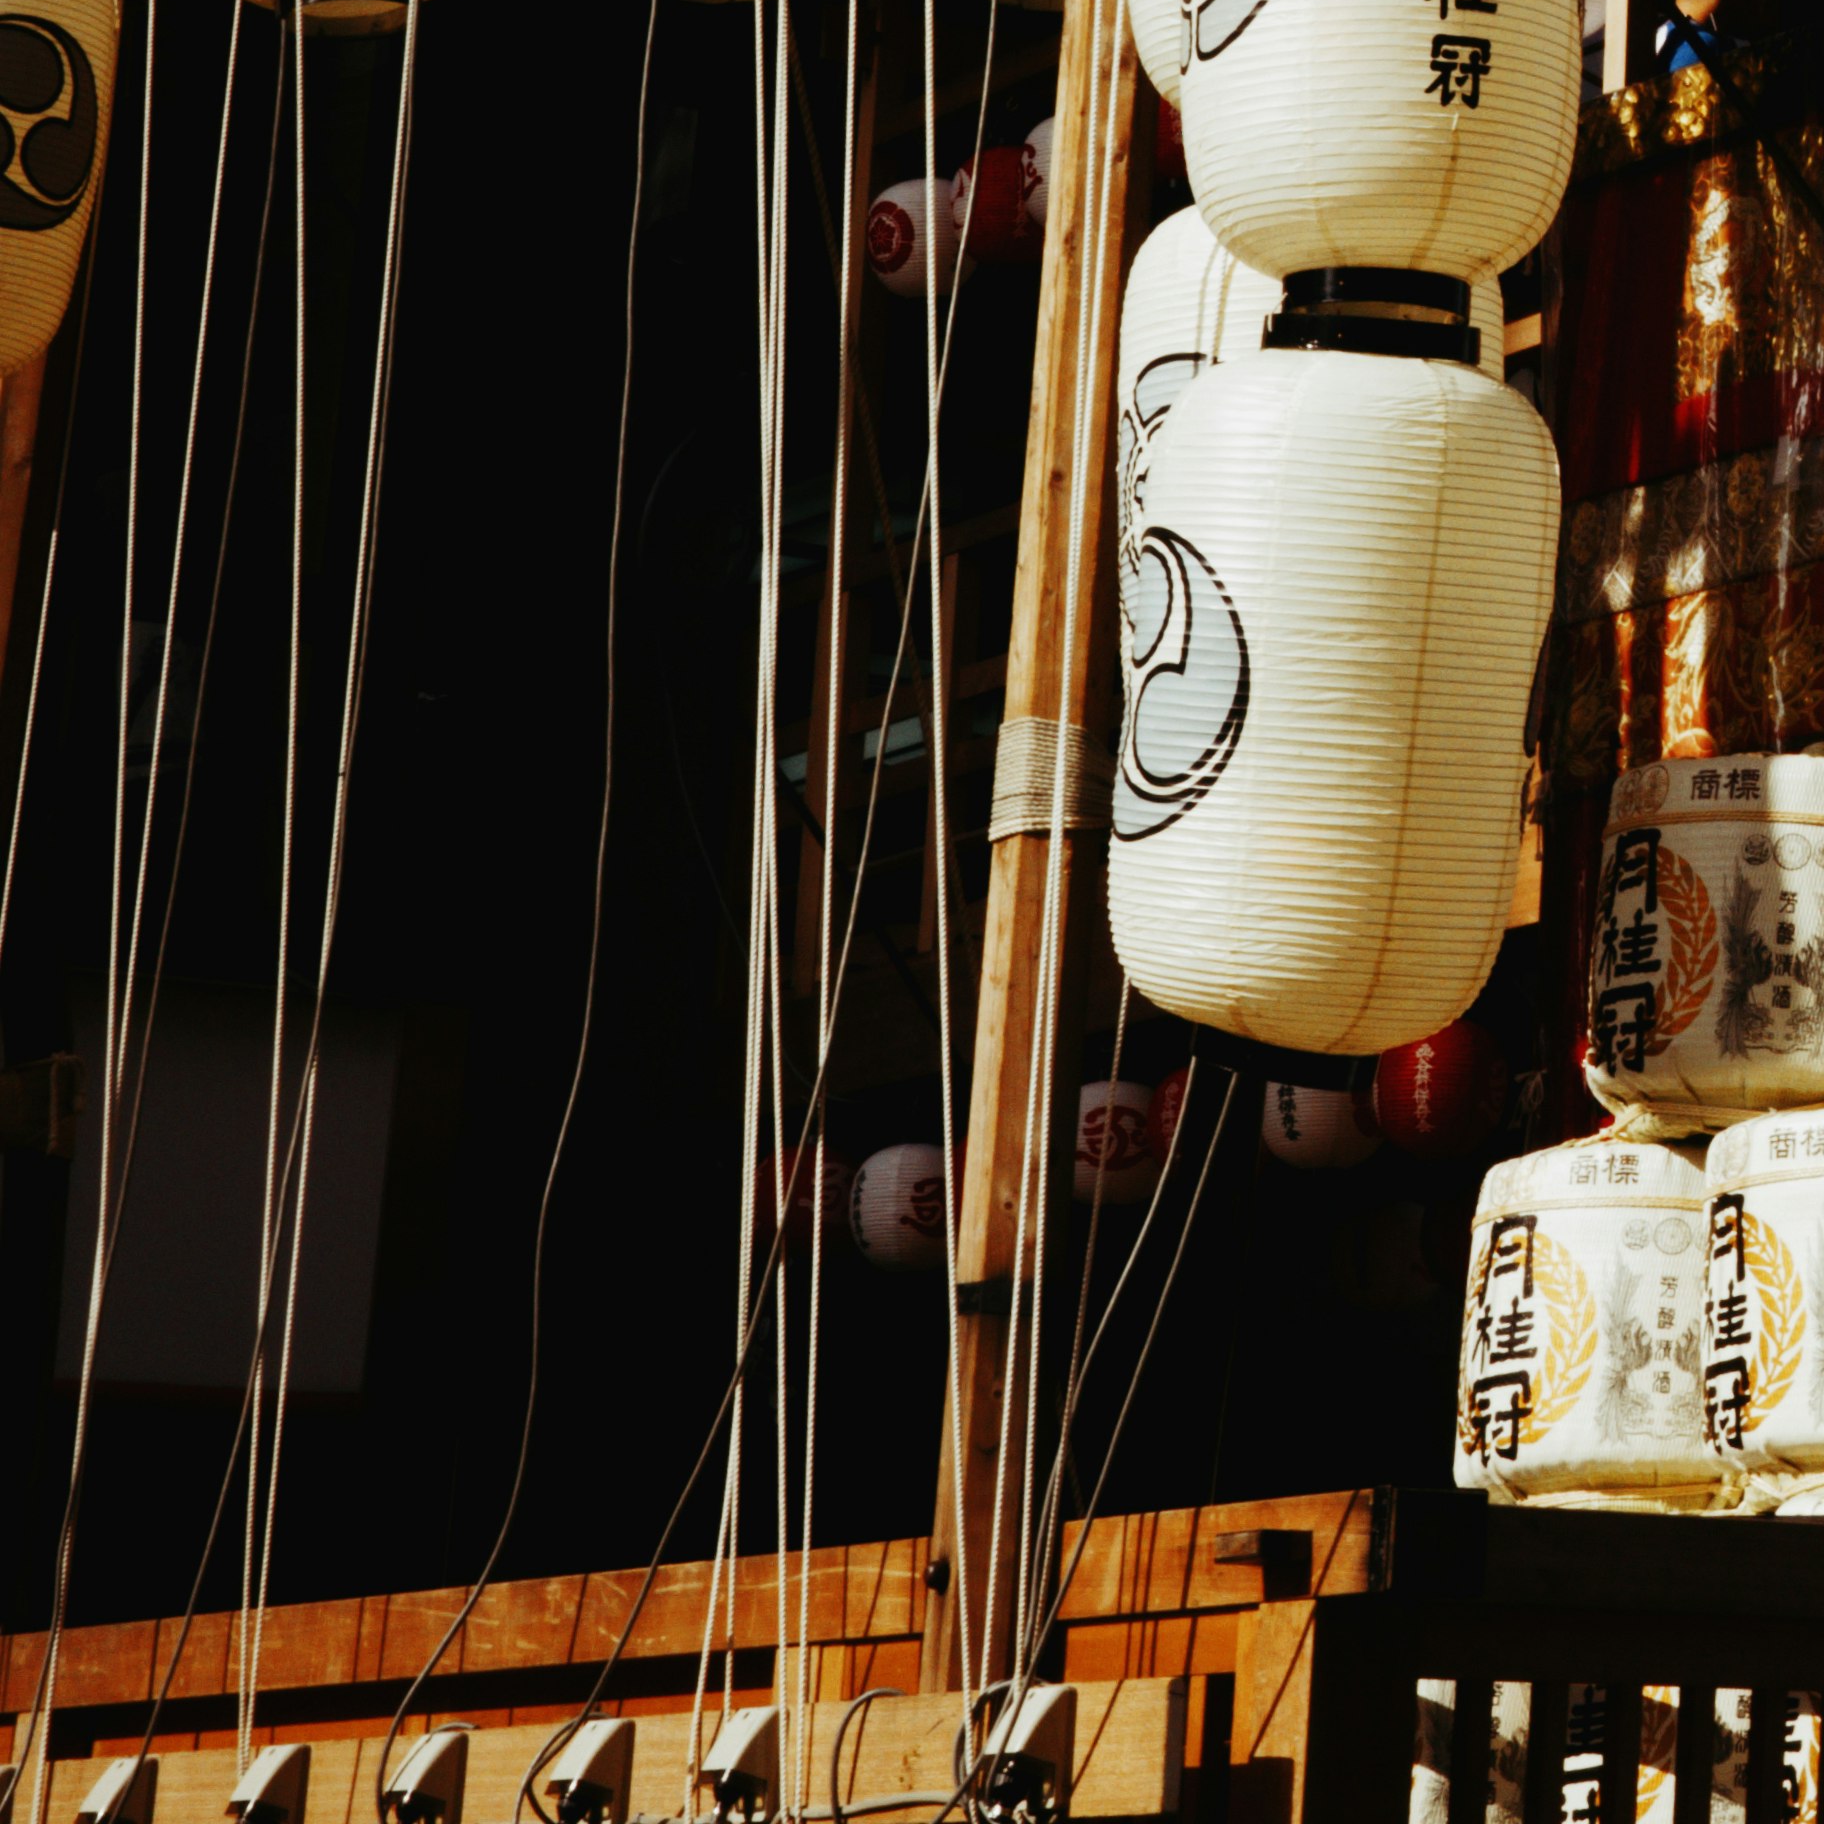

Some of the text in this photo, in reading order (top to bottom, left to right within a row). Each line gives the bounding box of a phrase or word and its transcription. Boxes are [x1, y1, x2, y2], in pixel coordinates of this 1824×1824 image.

[1690, 767, 1762, 803] 商標
[1592, 826, 1664, 1078] 月桂冠
[1569, 1153, 1641, 1185] 商標
[1470, 1214, 1538, 1463] 月桂冠
[1704, 1192, 1752, 1458] 月桂冠
